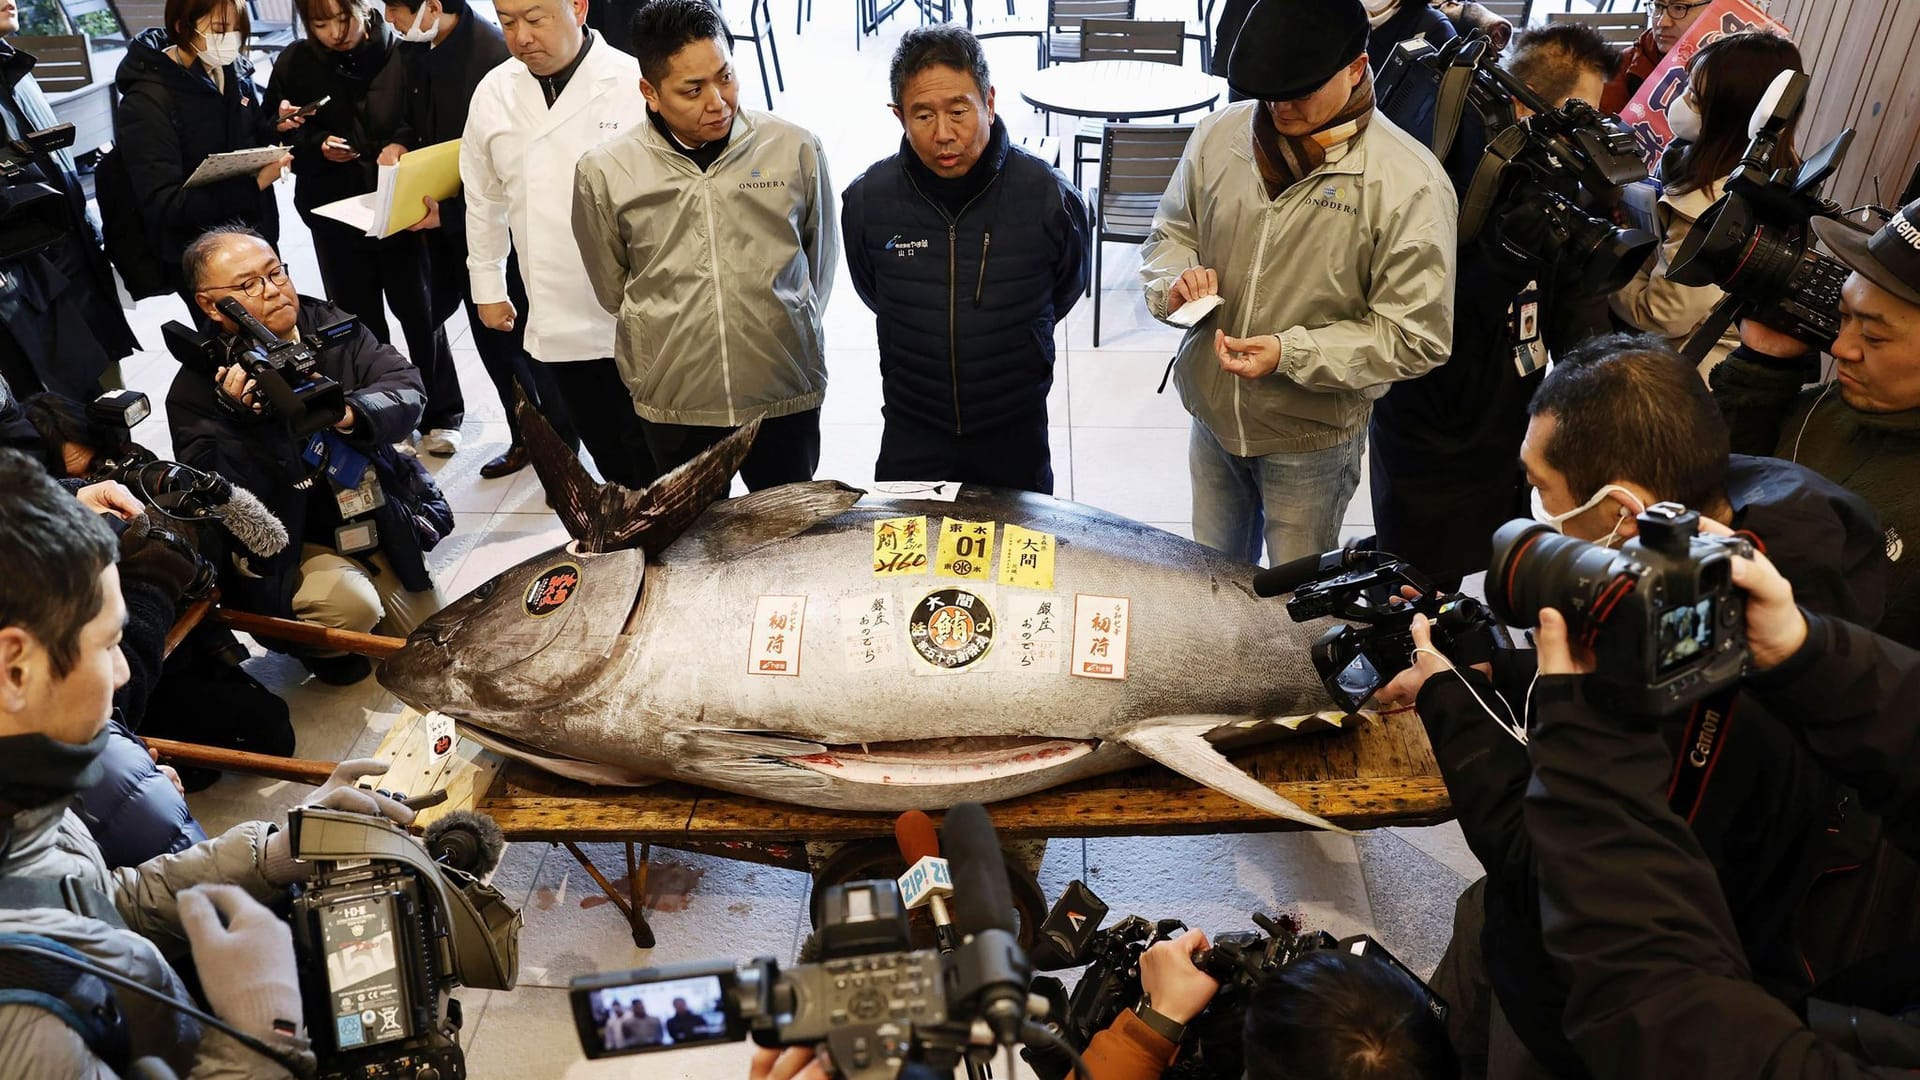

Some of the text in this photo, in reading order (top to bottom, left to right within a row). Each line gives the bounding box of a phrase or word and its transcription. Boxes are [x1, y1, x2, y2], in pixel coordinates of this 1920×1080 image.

[738, 181, 785, 189] ONODERA
[1305, 198, 1357, 215] ONODERA
[898, 249, 914, 257] 山口
[956, 536, 986, 558] 01
[1020, 537, 1039, 569] 大間
[871, 598, 890, 627] 銀座
[1035, 601, 1056, 634] 銀座
[766, 612, 788, 655] 初荷
[859, 615, 876, 664] おのでら
[1021, 618, 1035, 667] おのでら
[1090, 612, 1111, 658] 初荷
[1690, 710, 1720, 768] Canon
[901, 863, 929, 903] ZIP!
